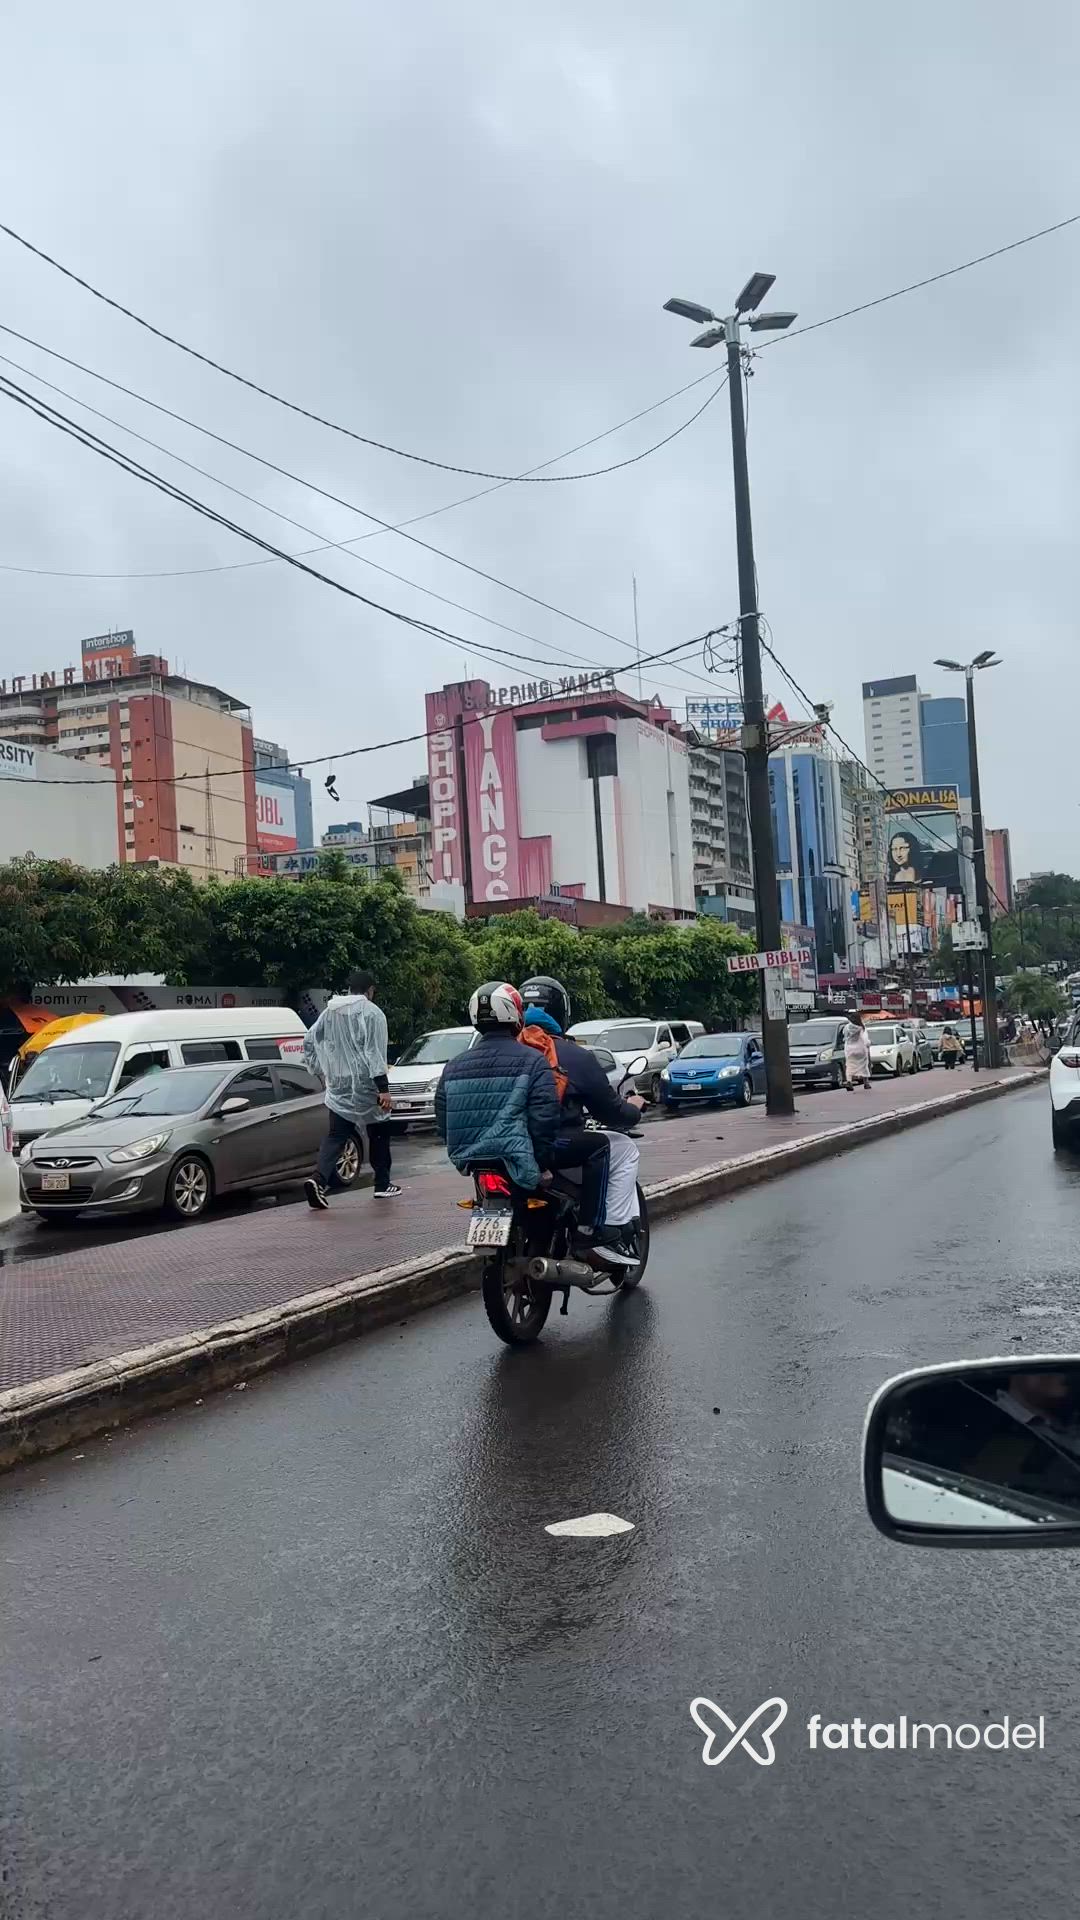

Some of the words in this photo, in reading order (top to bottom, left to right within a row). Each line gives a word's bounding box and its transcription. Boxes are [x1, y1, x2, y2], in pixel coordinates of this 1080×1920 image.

[701, 720, 741, 729] SHOP
[729, 955, 760, 970] LEIA
[476, 1217, 500, 1230] 776
